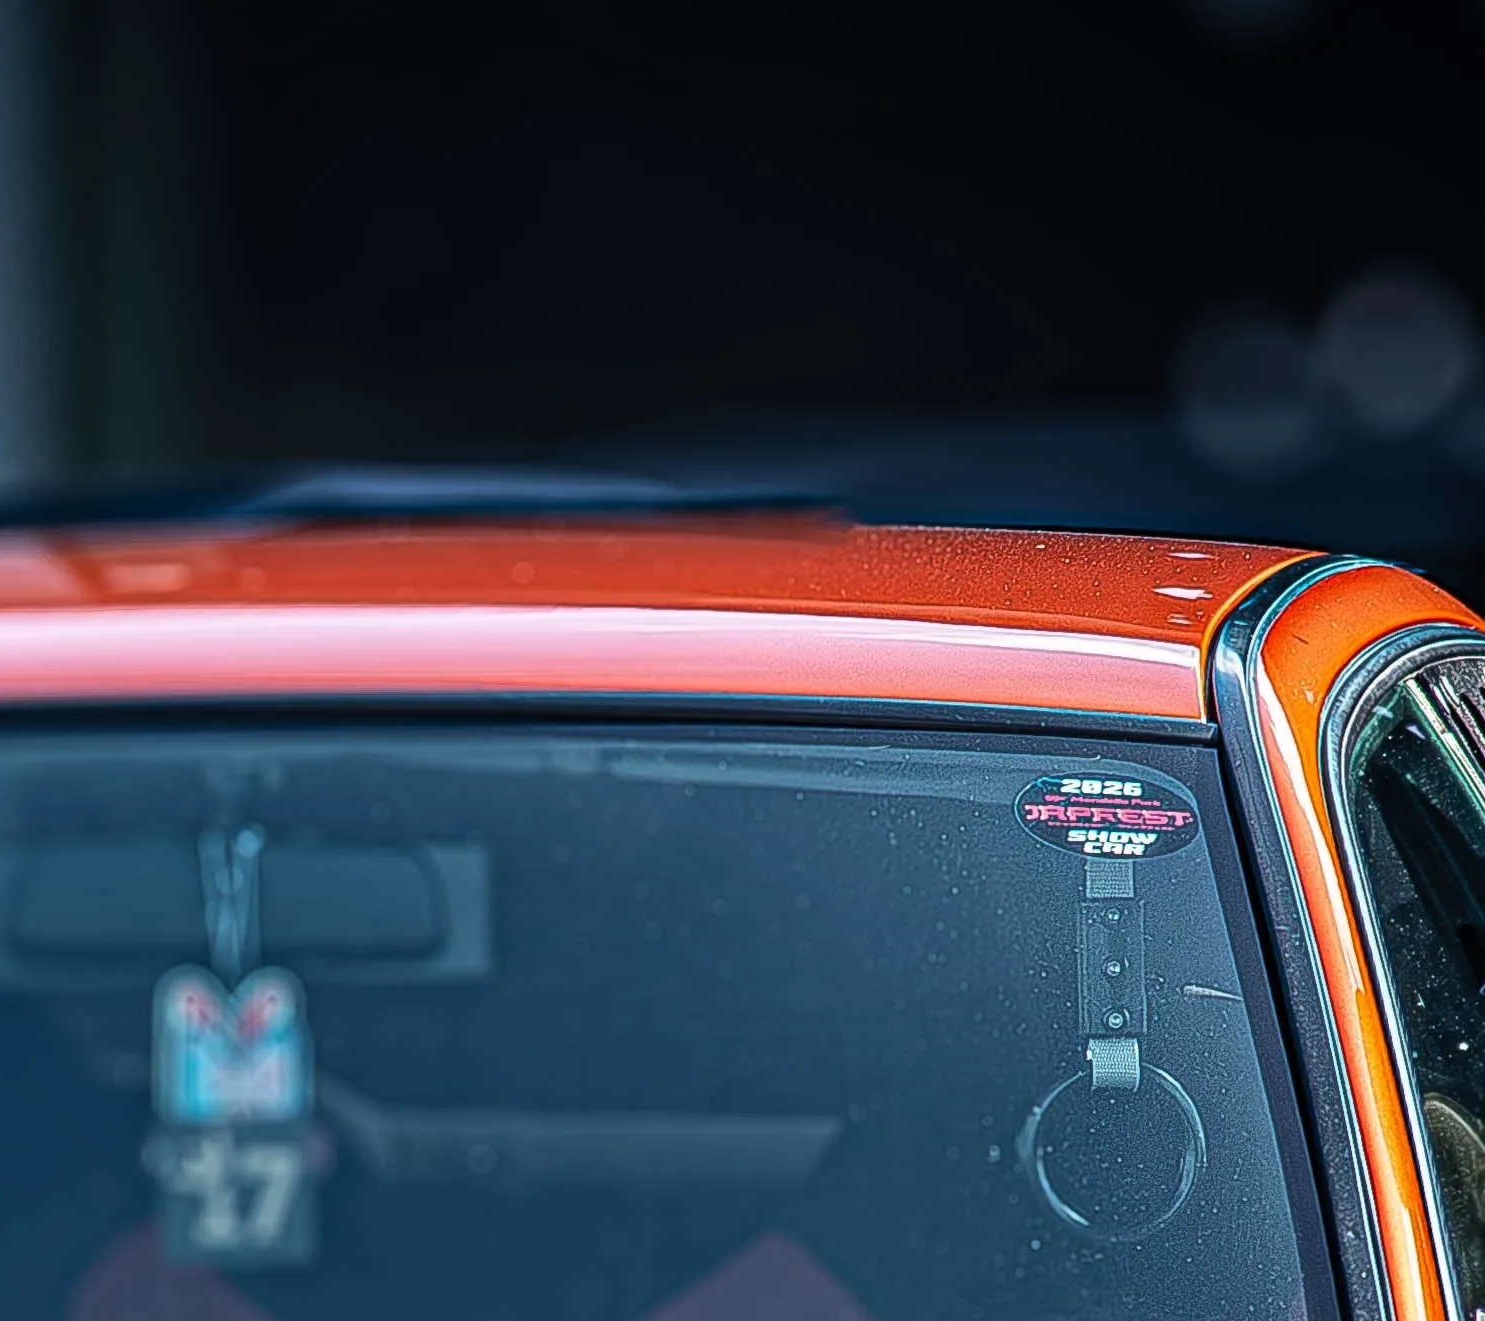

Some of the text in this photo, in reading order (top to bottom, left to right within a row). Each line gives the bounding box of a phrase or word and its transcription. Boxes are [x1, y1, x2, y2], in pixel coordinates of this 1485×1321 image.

[1060, 778, 1143, 797] 2026
[1067, 829, 1158, 845] SHOW
[1083, 841, 1145, 856] CAR
